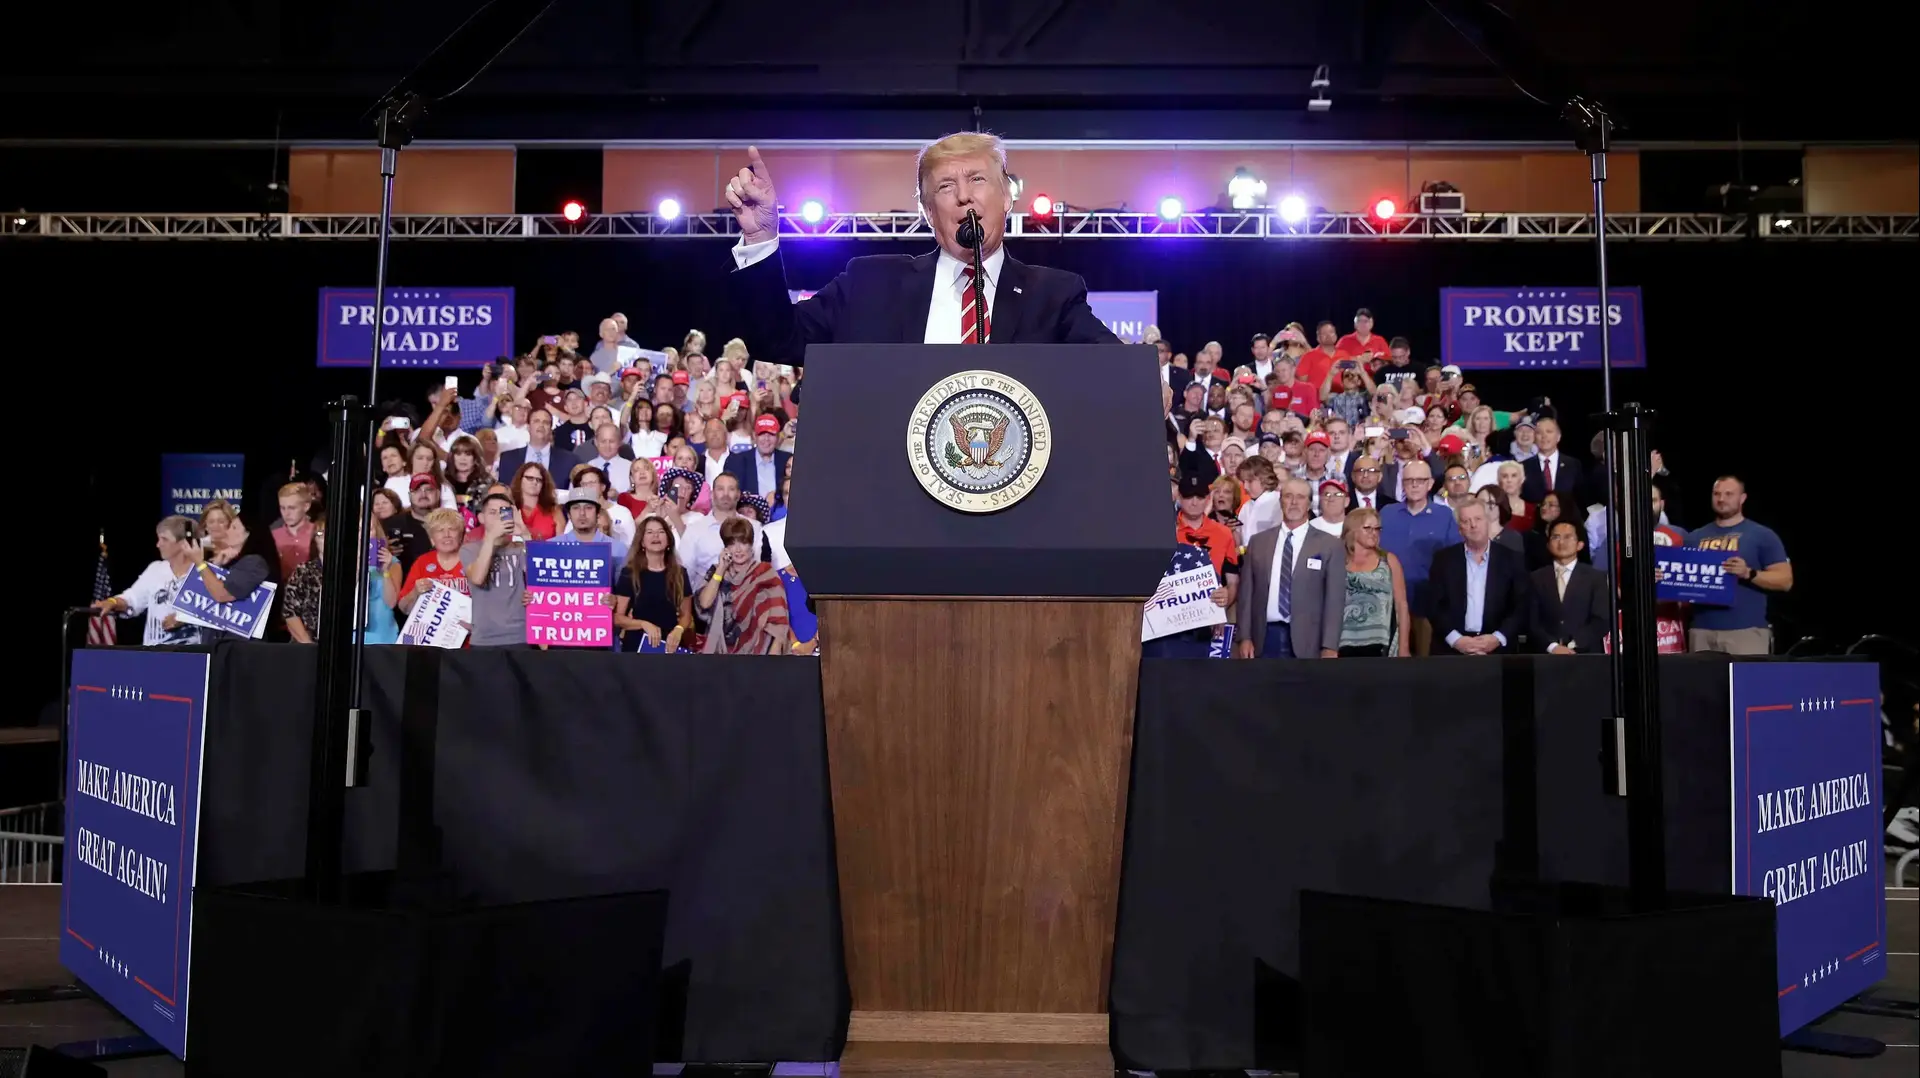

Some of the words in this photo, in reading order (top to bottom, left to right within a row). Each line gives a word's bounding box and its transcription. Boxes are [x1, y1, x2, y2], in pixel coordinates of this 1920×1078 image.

[340, 305, 492, 326] PROMISES
[1463, 304, 1622, 327] PROMISES
[1112, 320, 1142, 336] IN!
[372, 331, 459, 352] MADE
[1503, 331, 1584, 353] KEPT
[981, 377, 995, 387] OF
[997, 380, 1016, 395] THE
[912, 375, 977, 437] PRESIDENT
[1018, 393, 1047, 451] UNITED
[913, 441, 924, 461] THE
[917, 462, 930, 476] OF
[172, 488, 211, 499] MAKE
[212, 488, 243, 499] AME
[928, 477, 965, 505] SEAL
[990, 463, 1040, 506] STATES
[175, 503, 204, 515] GRE
[532, 557, 605, 570] TRUMP
[539, 569, 598, 579] PENCE
[1168, 570, 1213, 588] VETERANS
[1197, 578, 1215, 589] FOR
[1664, 573, 1723, 585] PENCE
[432, 587, 444, 603] FOR
[181, 589, 252, 627] SWAMP
[420, 590, 452, 645] TRUMP
[553, 611, 583, 622] FOR
[531, 626, 607, 642] TRUMP
[77, 759, 110, 802] MAKE
[111, 769, 176, 826] AMERICA
[1757, 785, 1806, 834] MAKE
[1808, 772, 1871, 820] AMERICA
[77, 826, 116, 877] GREAT
[116, 845, 168, 904] AGAIN!
[1763, 856, 1818, 907] GREAT
[1820, 839, 1868, 890] AGAIN!
